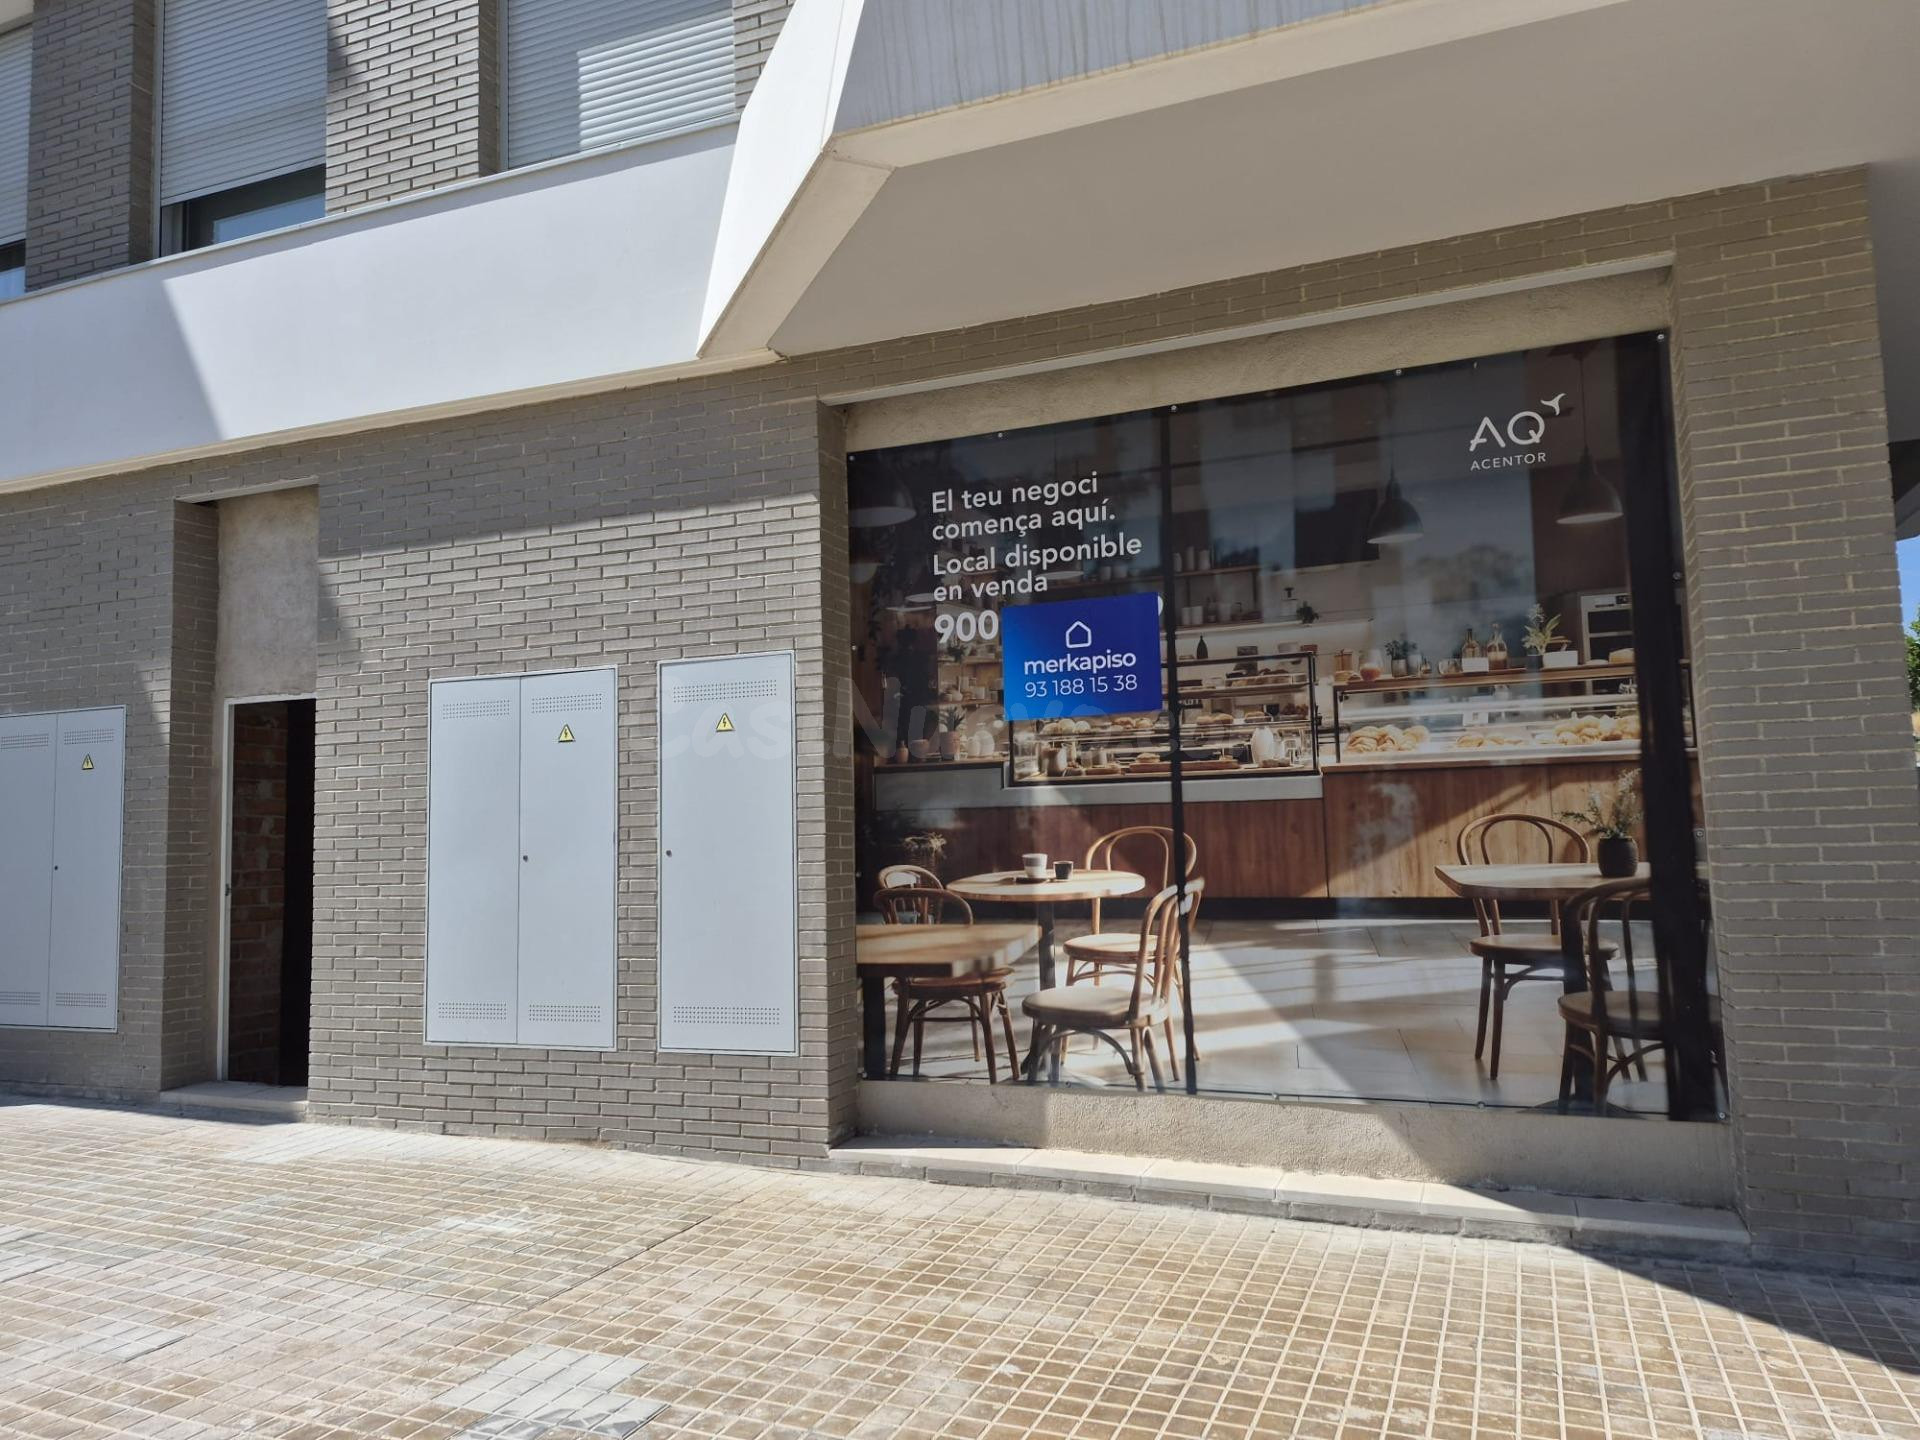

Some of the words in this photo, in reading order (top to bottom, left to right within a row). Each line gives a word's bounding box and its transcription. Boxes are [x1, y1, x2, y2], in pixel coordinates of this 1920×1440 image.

[1470, 452, 1547, 471] ACENTOR
[932, 489, 953, 513] El
[961, 489, 1002, 510] teu
[1012, 471, 1098, 506] negoci
[932, 513, 1042, 541] comença
[1051, 499, 1116, 531] aquí.
[933, 547, 996, 576] Local
[1005, 532, 1143, 568] disponible
[933, 583, 962, 602] en
[971, 570, 1048, 598] venda
[934, 609, 999, 644] 900
[1024, 649, 1137, 676] merkapiso
[1025, 681, 1048, 698] 93
[1052, 678, 1085, 696] 188
[1090, 676, 1109, 694] 15
[1113, 674, 1138, 692] 38
